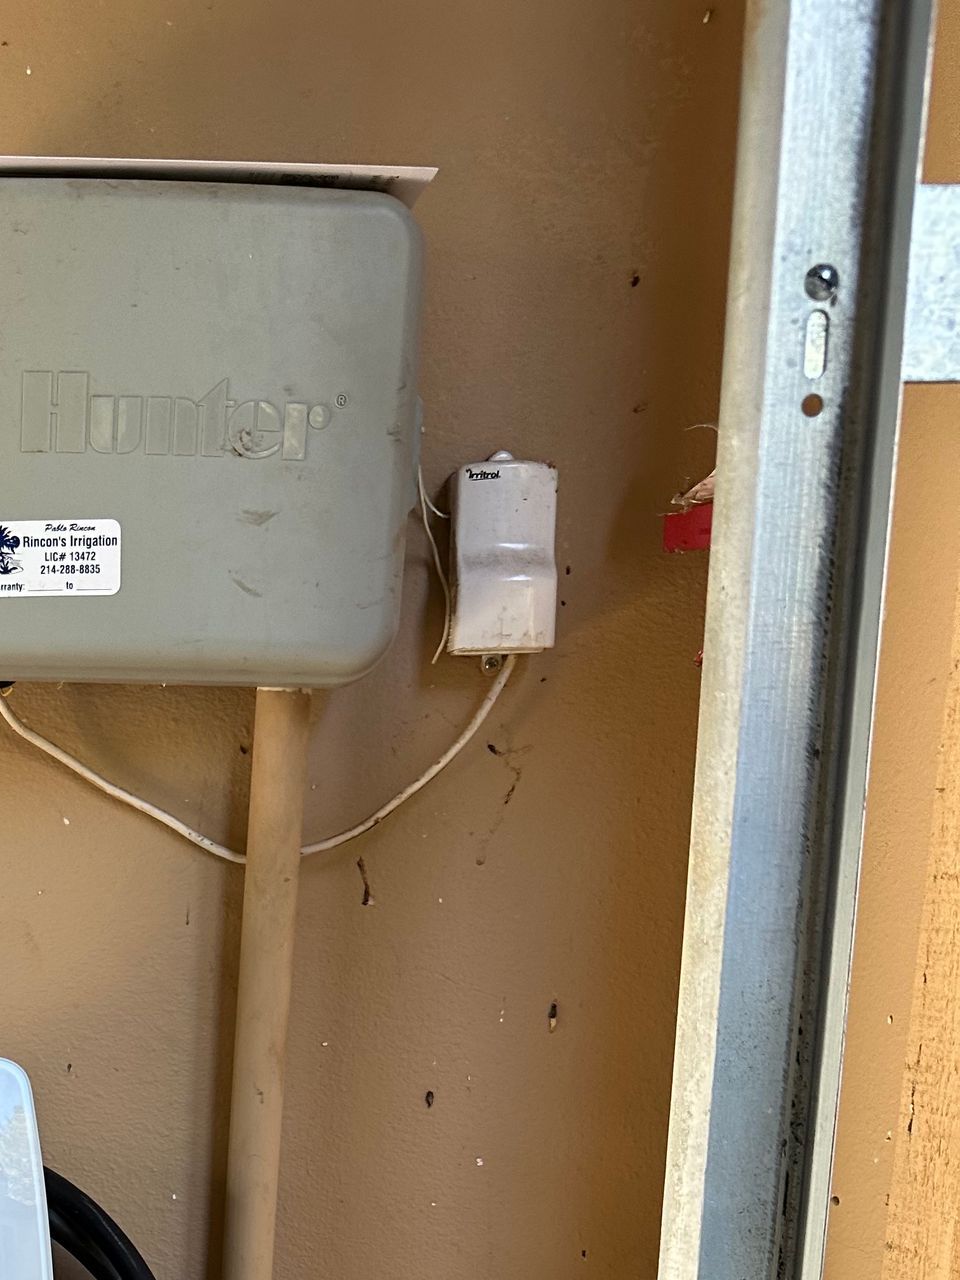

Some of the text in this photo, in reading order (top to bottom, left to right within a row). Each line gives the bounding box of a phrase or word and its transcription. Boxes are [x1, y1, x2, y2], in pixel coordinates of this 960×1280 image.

[465, 468, 501, 481] Irritrol
[44, 523, 96, 532] Pablo Rincon
[23, 535, 118, 549] Rincon's Irrigation
[44, 551, 96, 562] LIC# 13472
[40, 564, 101, 575] 214-288-8835
[66, 581, 73, 590] to
